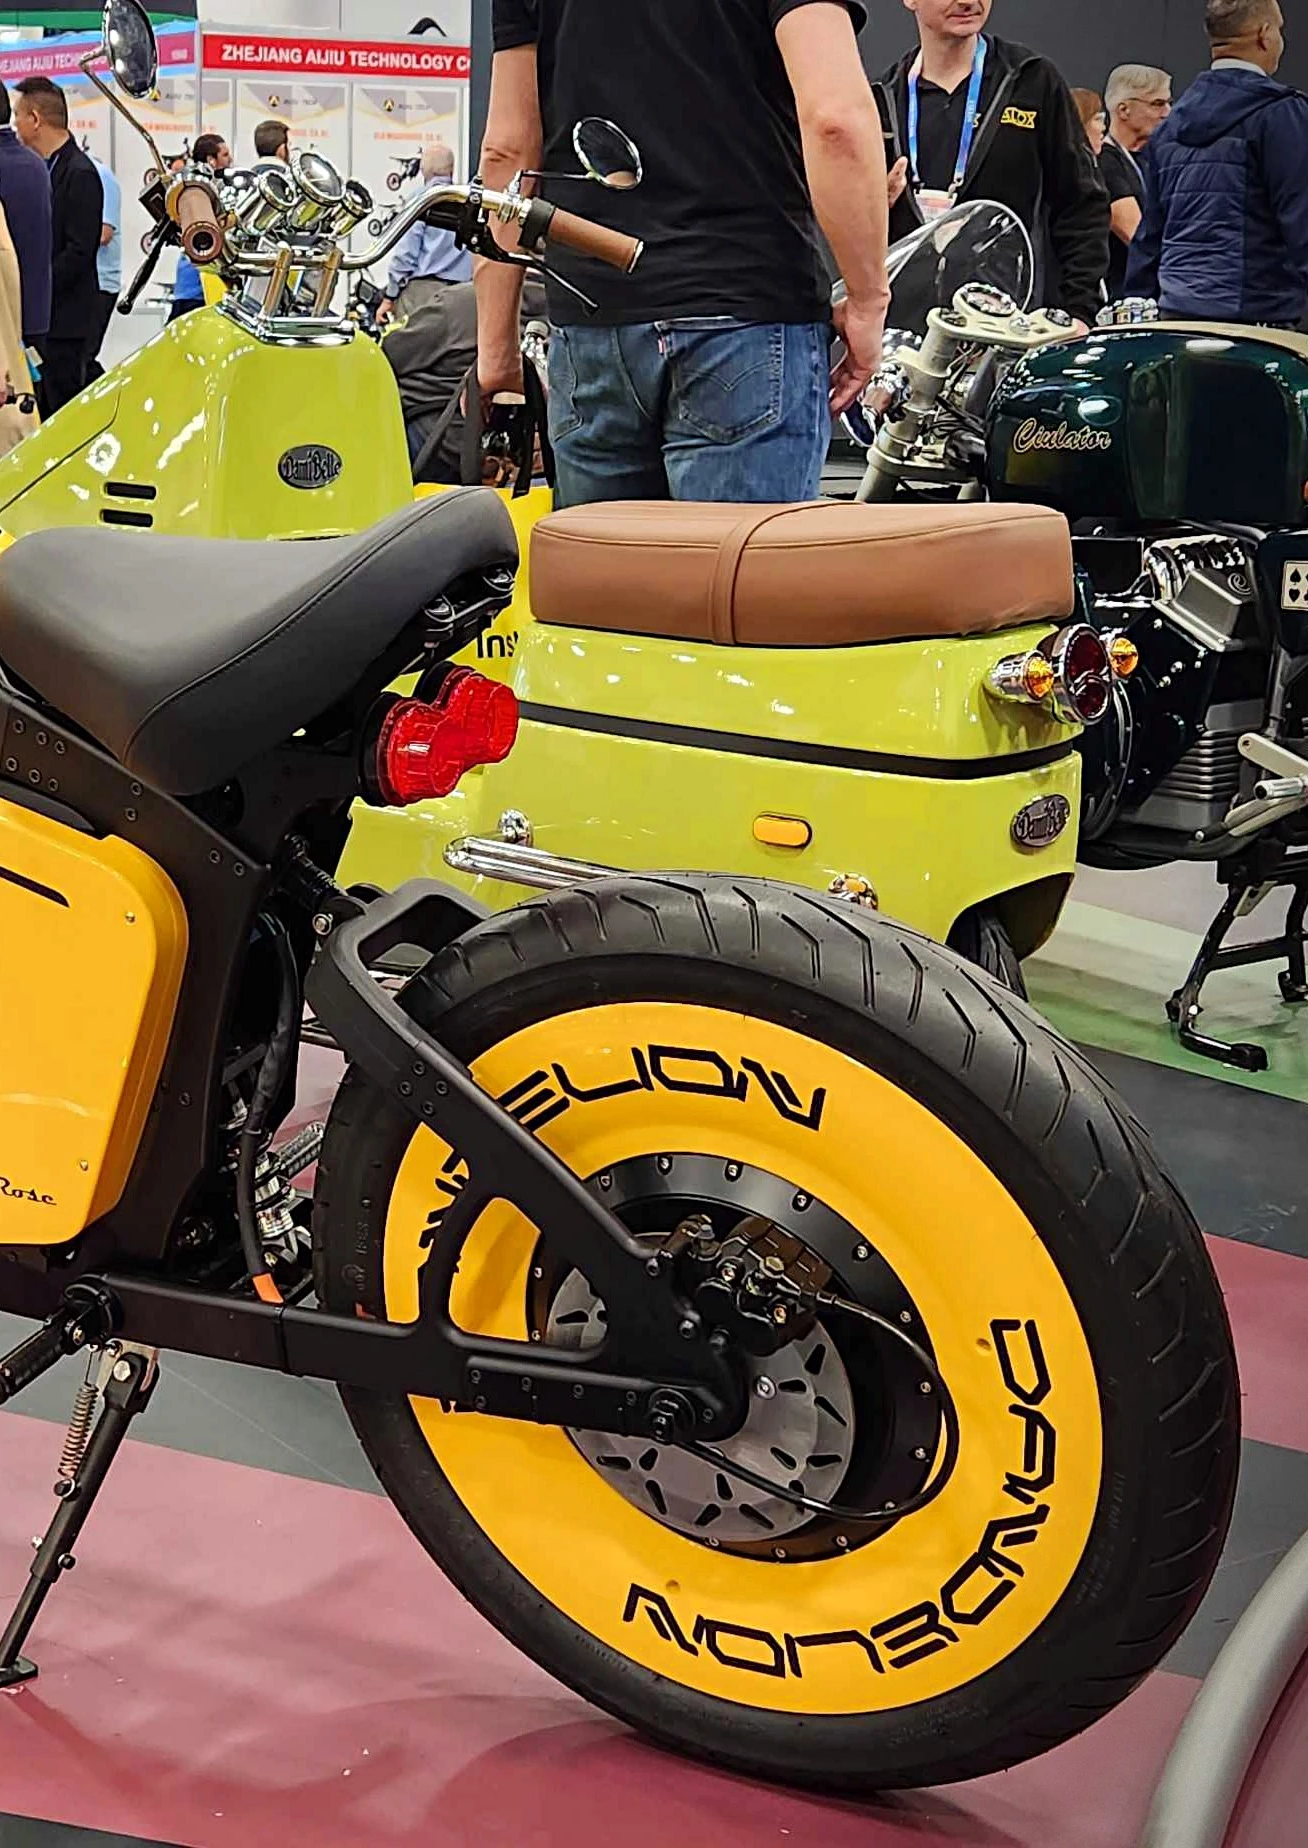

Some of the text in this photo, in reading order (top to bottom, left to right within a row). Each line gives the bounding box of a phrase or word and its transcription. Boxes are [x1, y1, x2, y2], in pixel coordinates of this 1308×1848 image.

[222, 45, 302, 64] ZHEJIANG
[305, 47, 344, 66] AIJIU
[349, 51, 454, 71] TECHNOLOGY
[623, 1319, 1057, 1678] DANDELION
